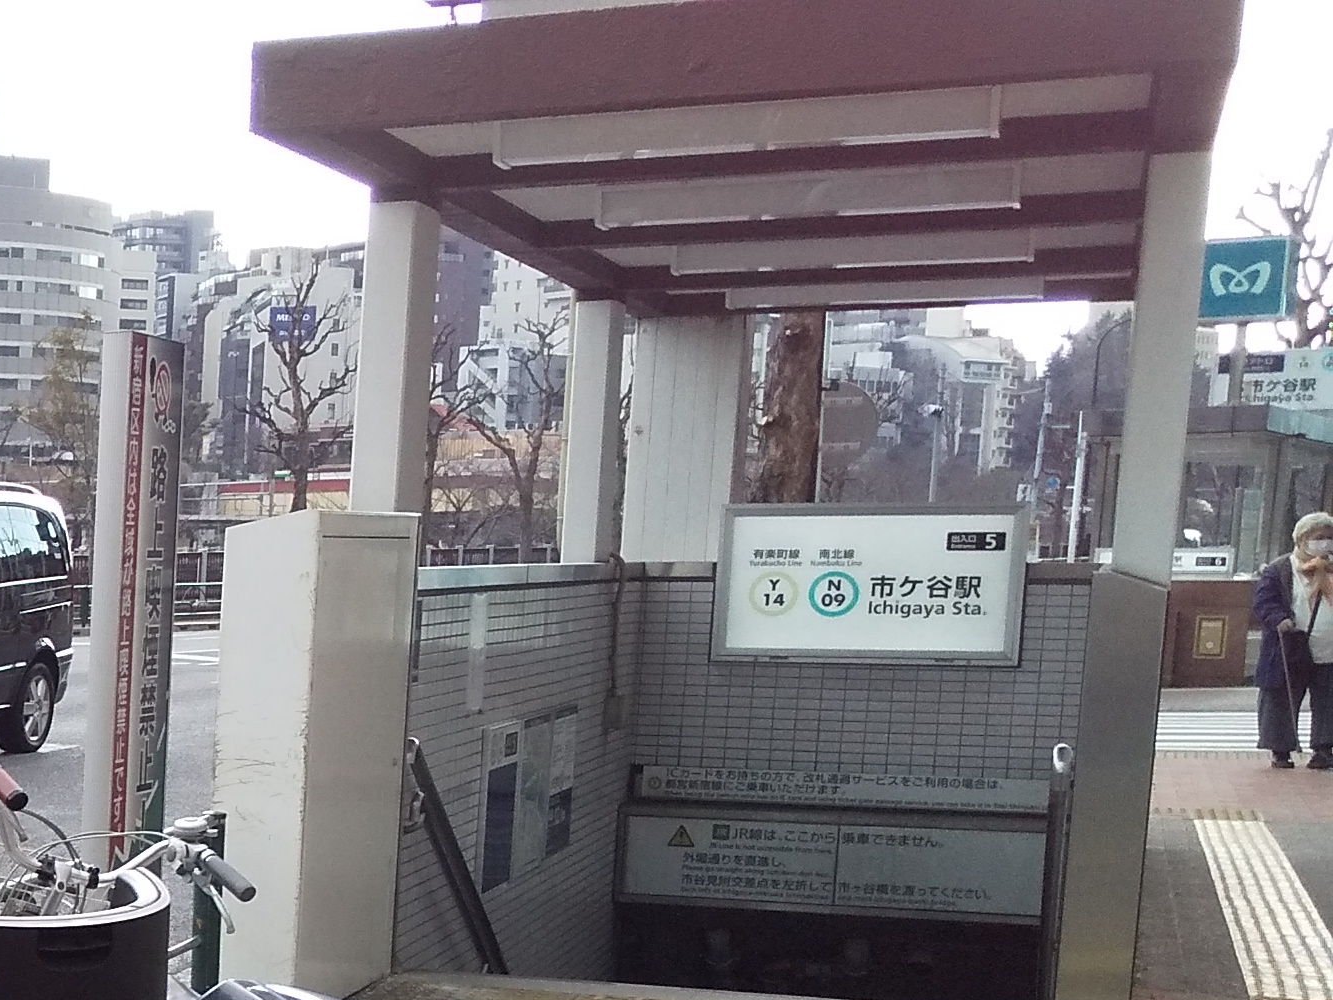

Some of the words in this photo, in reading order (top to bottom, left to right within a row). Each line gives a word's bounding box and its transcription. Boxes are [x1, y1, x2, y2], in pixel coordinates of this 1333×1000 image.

[951, 533, 977, 543] 出入口
[985, 534, 997, 549] 5
[753, 548, 801, 560] 有楽町線
[819, 548, 855, 560] 南北線
[769, 579, 781, 592] Y
[827, 579, 842, 592] N
[763, 593, 785, 607] 14
[821, 593, 846, 607] 09
[868, 600, 945, 619] Ichigaya
[952, 600, 987, 616] Sta.
